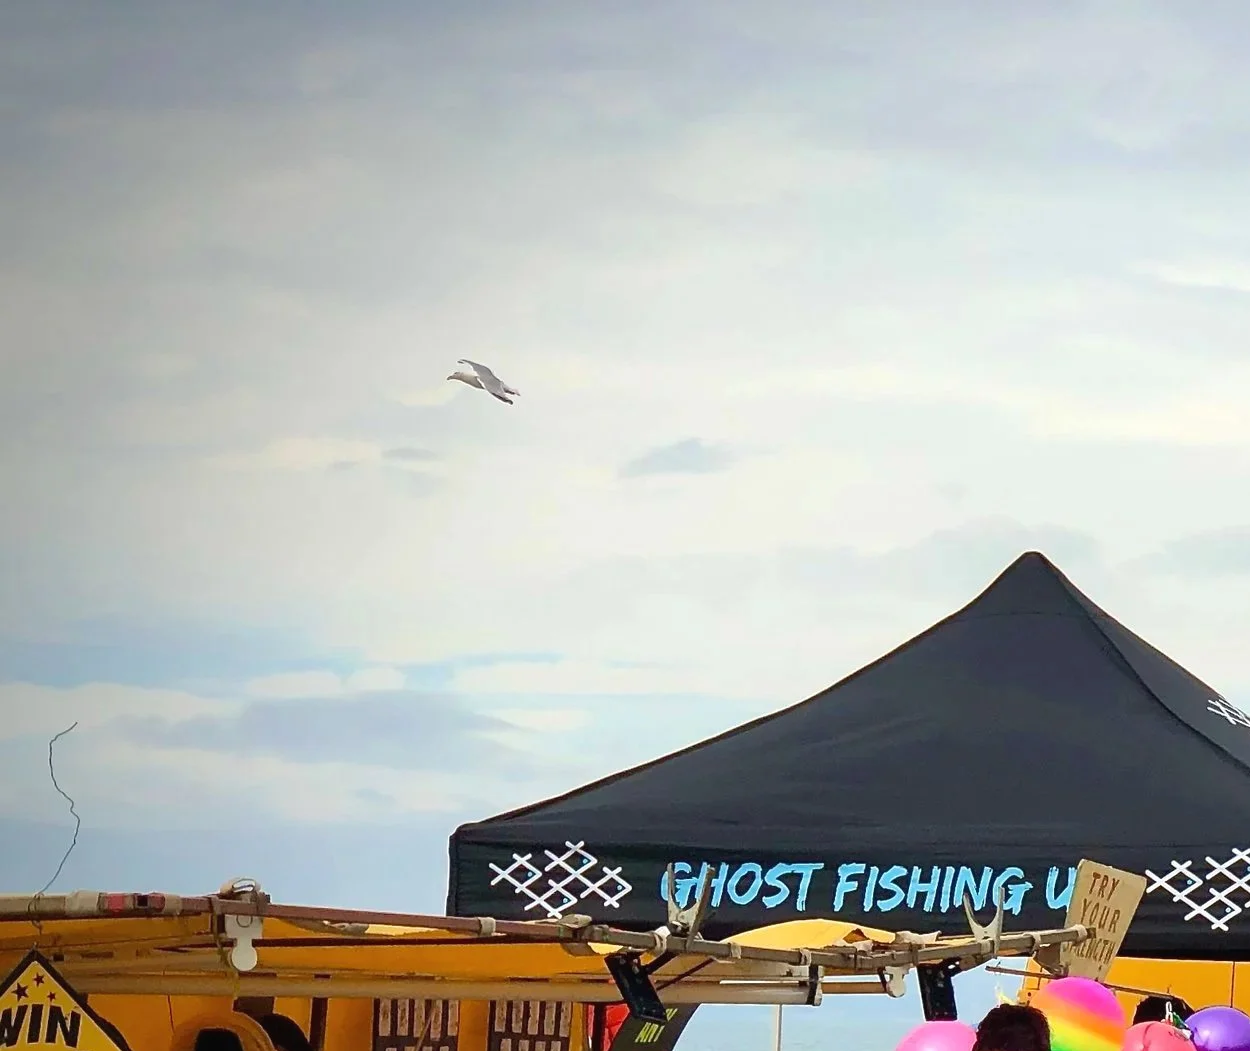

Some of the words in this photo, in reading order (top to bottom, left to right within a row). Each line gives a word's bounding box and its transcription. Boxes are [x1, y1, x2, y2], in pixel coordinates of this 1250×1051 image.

[660, 861, 825, 913] GHOST
[833, 862, 1034, 916] FISHING
[1045, 865, 1078, 914] U
[1088, 872, 1120, 901] TRY
[1080, 898, 1121, 934] YOUR
